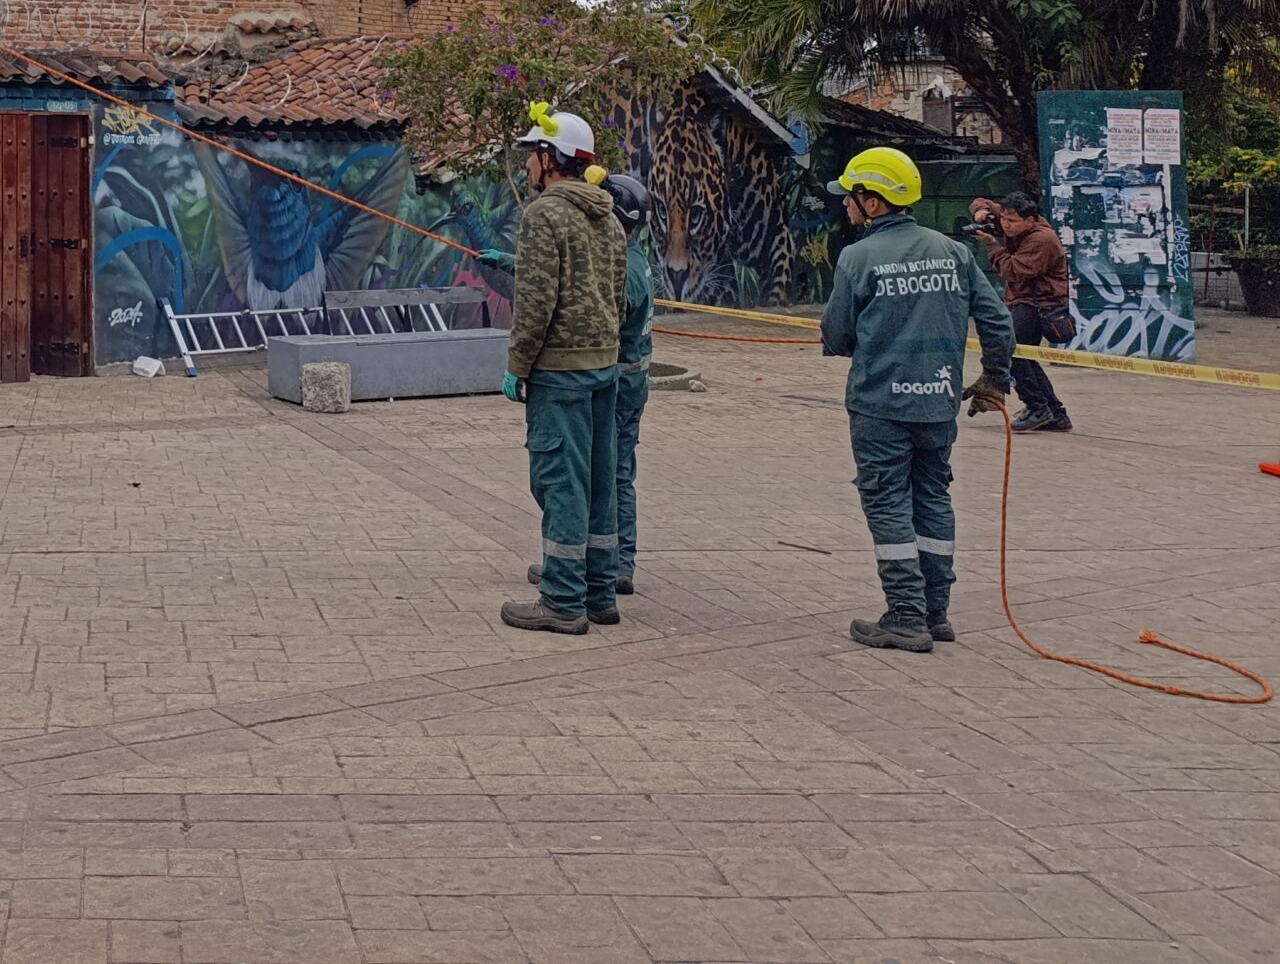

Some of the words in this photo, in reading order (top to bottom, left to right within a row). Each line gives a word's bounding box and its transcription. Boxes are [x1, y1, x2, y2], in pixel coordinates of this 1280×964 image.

[908, 257, 956, 273] BOTÁNICO
[875, 278, 896, 297] DE
[896, 269, 962, 296] BOGOTÁ
